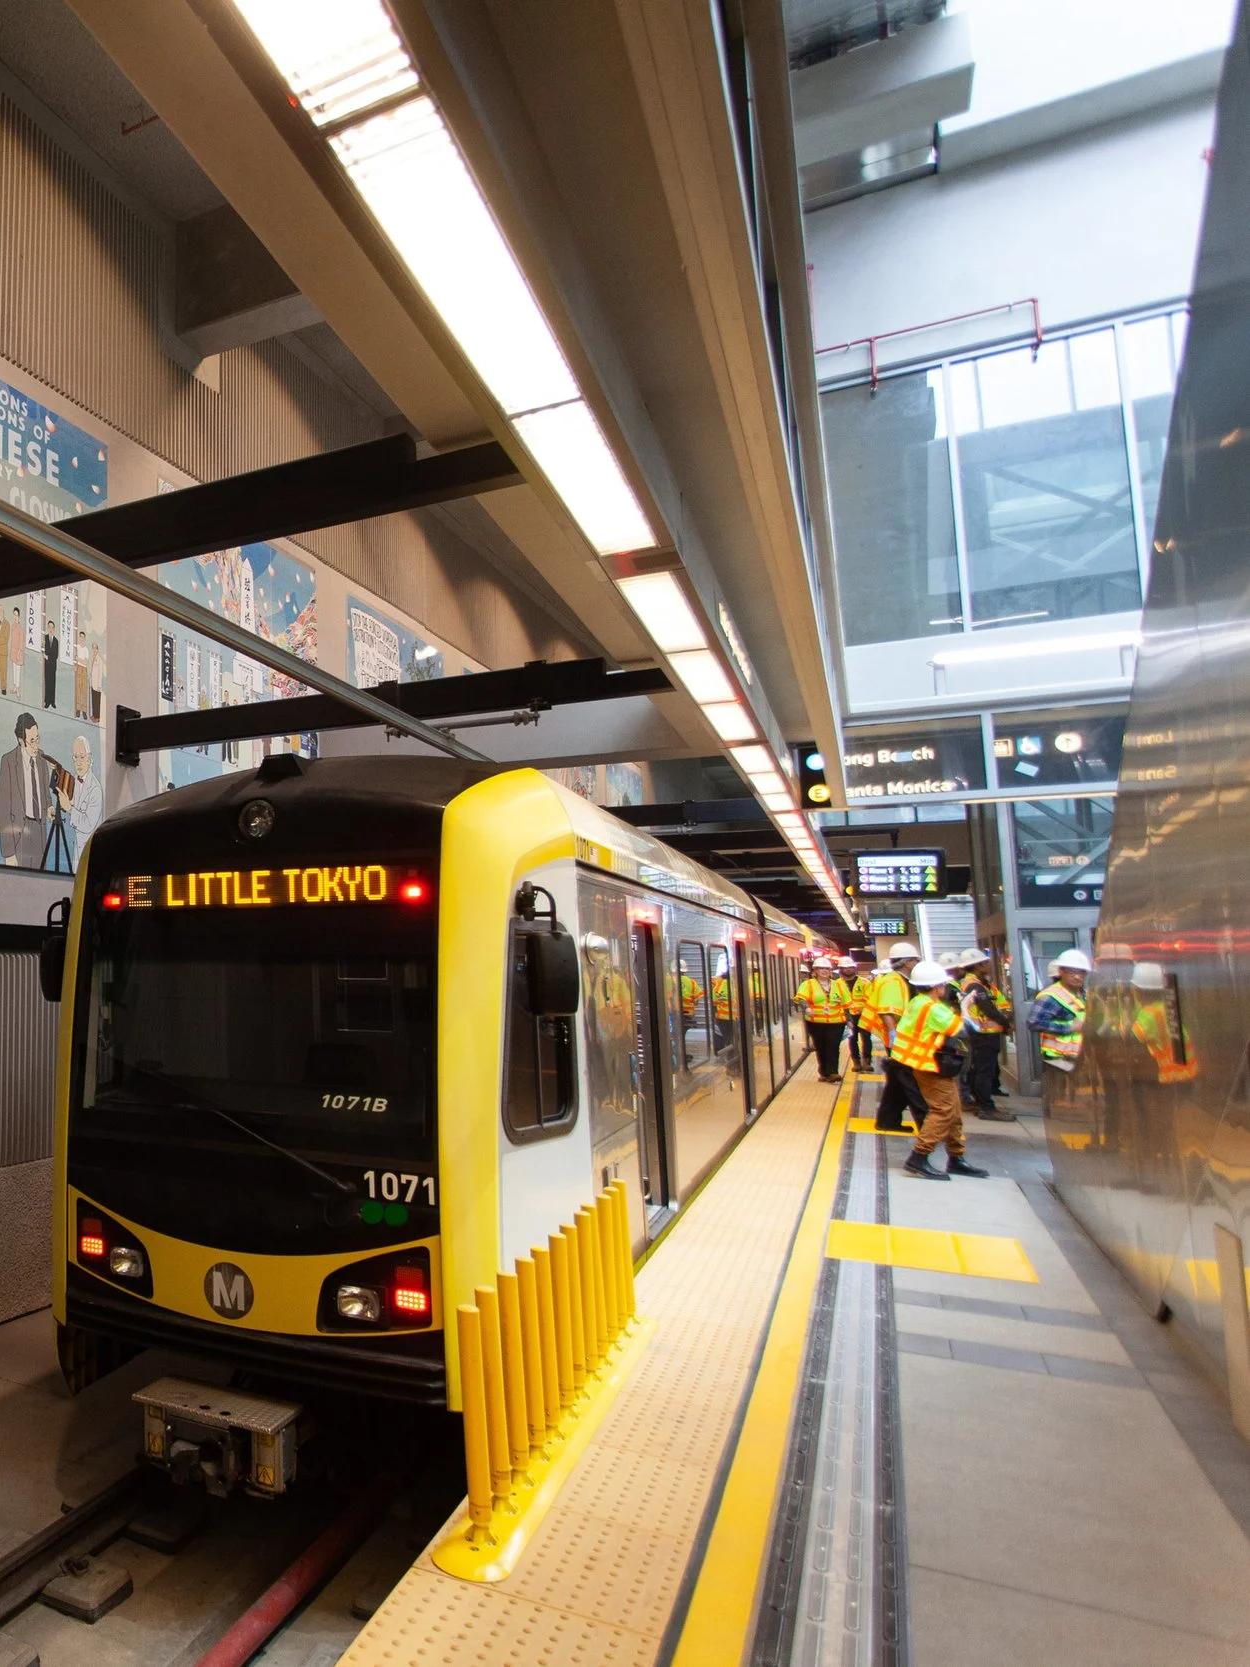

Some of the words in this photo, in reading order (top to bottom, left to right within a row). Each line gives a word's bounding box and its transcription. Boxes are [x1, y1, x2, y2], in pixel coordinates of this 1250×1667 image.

[33, 424, 51, 444] OF
[844, 752, 875, 767] ong
[878, 745, 934, 763] Bech
[846, 784, 884, 797] anta
[887, 779, 953, 795] Monica
[128, 875, 152, 907] E
[167, 870, 271, 907] LITTLE
[283, 865, 387, 903] TOKYO
[321, 1094, 388, 1112] 1071B
[363, 1170, 435, 1206] 1071
[212, 1269, 245, 1311] M
